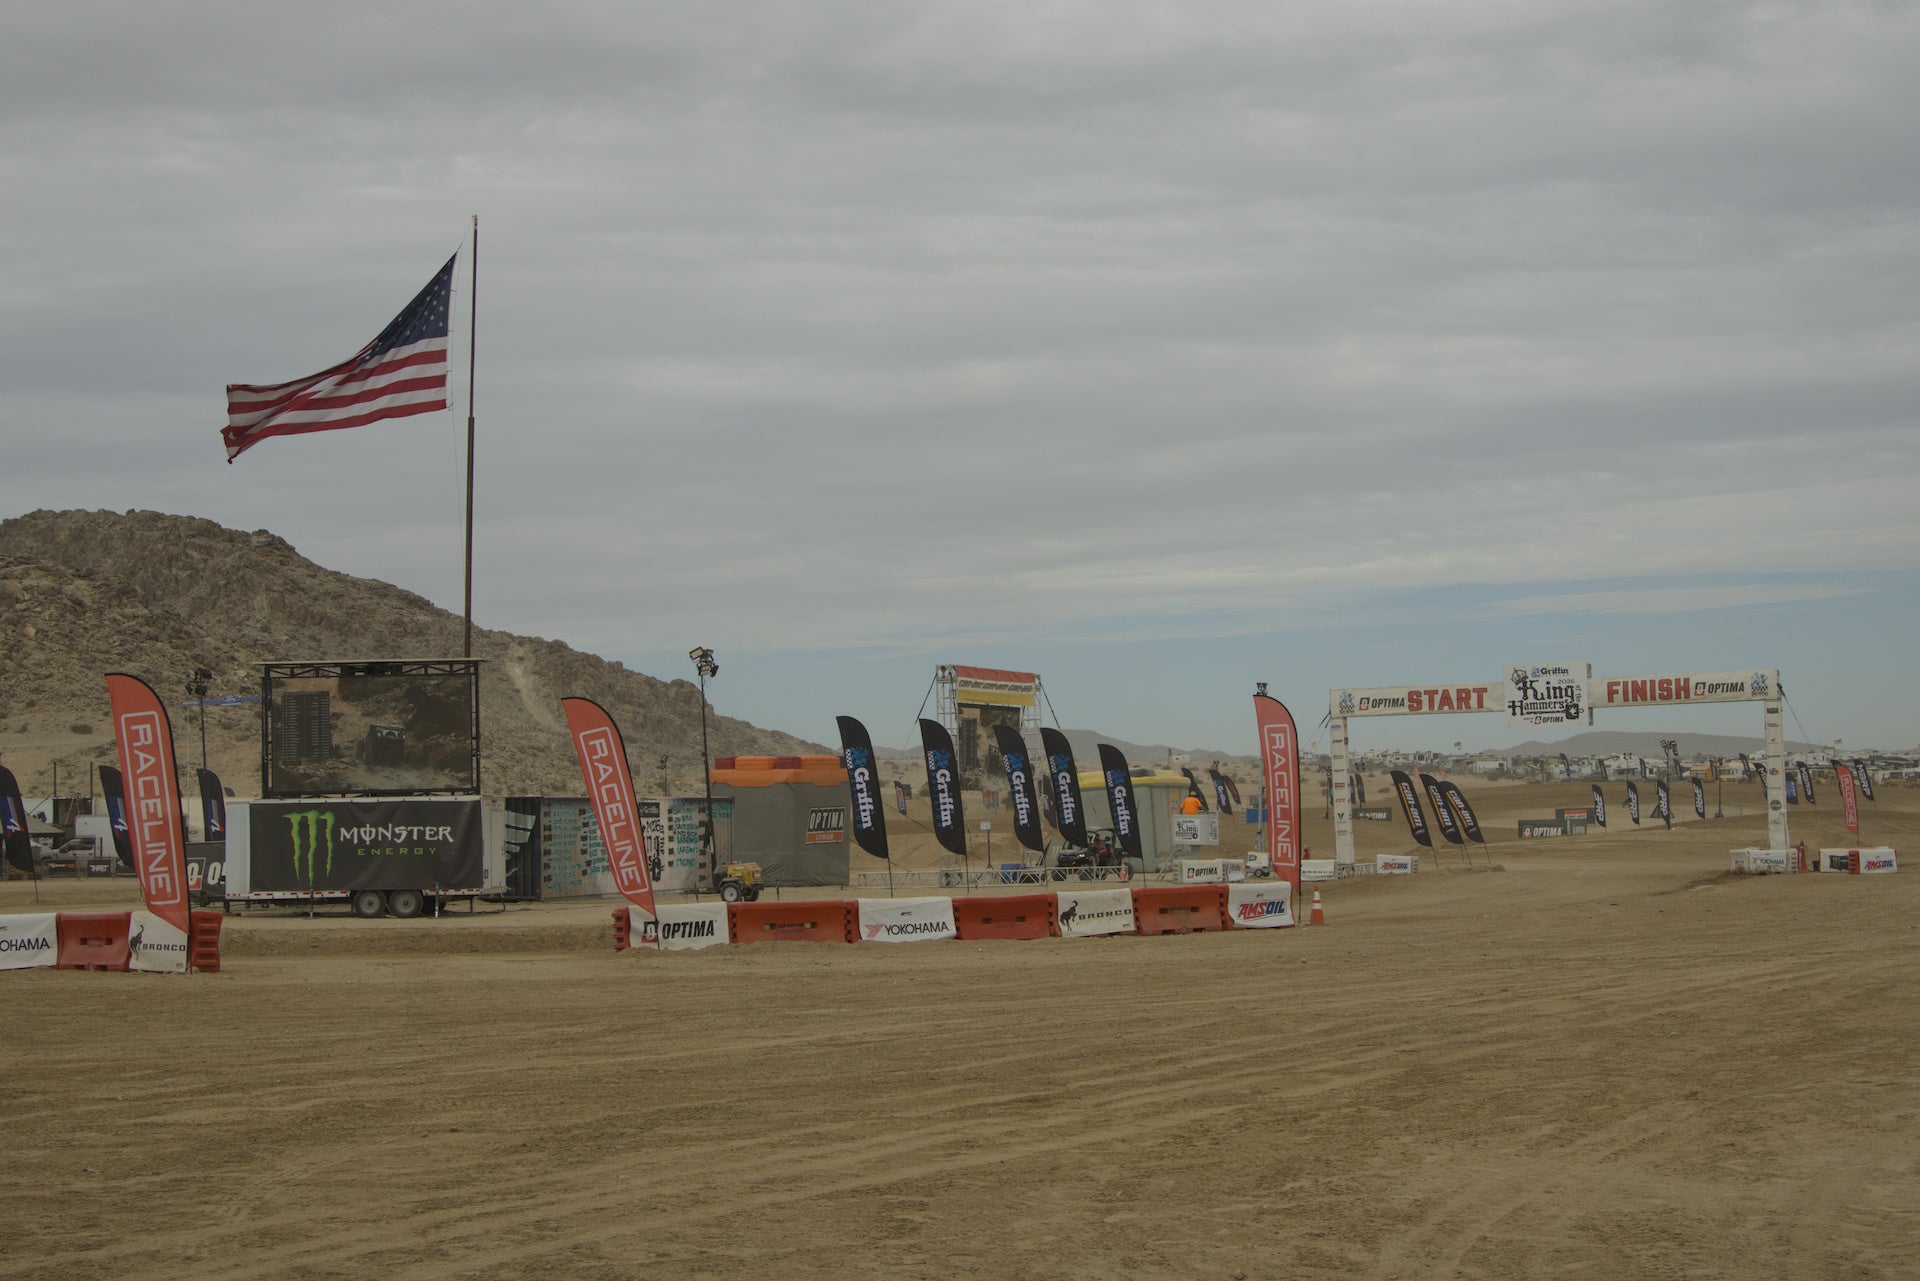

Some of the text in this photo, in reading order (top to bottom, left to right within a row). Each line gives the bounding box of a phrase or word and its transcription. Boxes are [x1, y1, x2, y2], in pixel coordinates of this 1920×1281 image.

[1541, 667, 1569, 675] Griffin
[1407, 687, 1488, 712] START
[1517, 679, 1575, 703] King
[1607, 677, 1691, 703] FINISH
[1707, 682, 1745, 694] OPTIMA
[1371, 698, 1405, 709] OPTIMA
[1507, 700, 1566, 716] Hammers
[1800, 767, 1812, 796] MBRP
[1856, 764, 1871, 796] MBRP
[853, 767, 874, 829] Griffin
[935, 769, 956, 828] Griffin
[1011, 771, 1031, 826] Griffin
[1058, 771, 1076, 825] Griffin
[1270, 733, 1292, 859] RACELINE
[1401, 782, 1423, 827] can-am
[1430, 785, 1452, 826] can-am
[130, 723, 172, 896] RACELINE
[588, 738, 641, 887] RACELINE
[1114, 786, 1132, 836] Griffin
[1448, 790, 1474, 826] can-am
[809, 811, 844, 830] OPTIMA
[1533, 827, 1562, 837] OPTIMA
[339, 822, 455, 845] MONSTER
[357, 847, 437, 856] ENERGY
[1195, 867, 1218, 877] OPTIMA
[1381, 862, 1408, 870] AMSOIL
[1864, 860, 1894, 870] AMSOIL
[1078, 908, 1132, 921] BRONCO
[1237, 900, 1286, 920] AMSOIL
[661, 920, 715, 940] OPTIMA
[884, 921, 950, 936] YOKOHAMA
[143, 943, 186, 952] BRONCO
